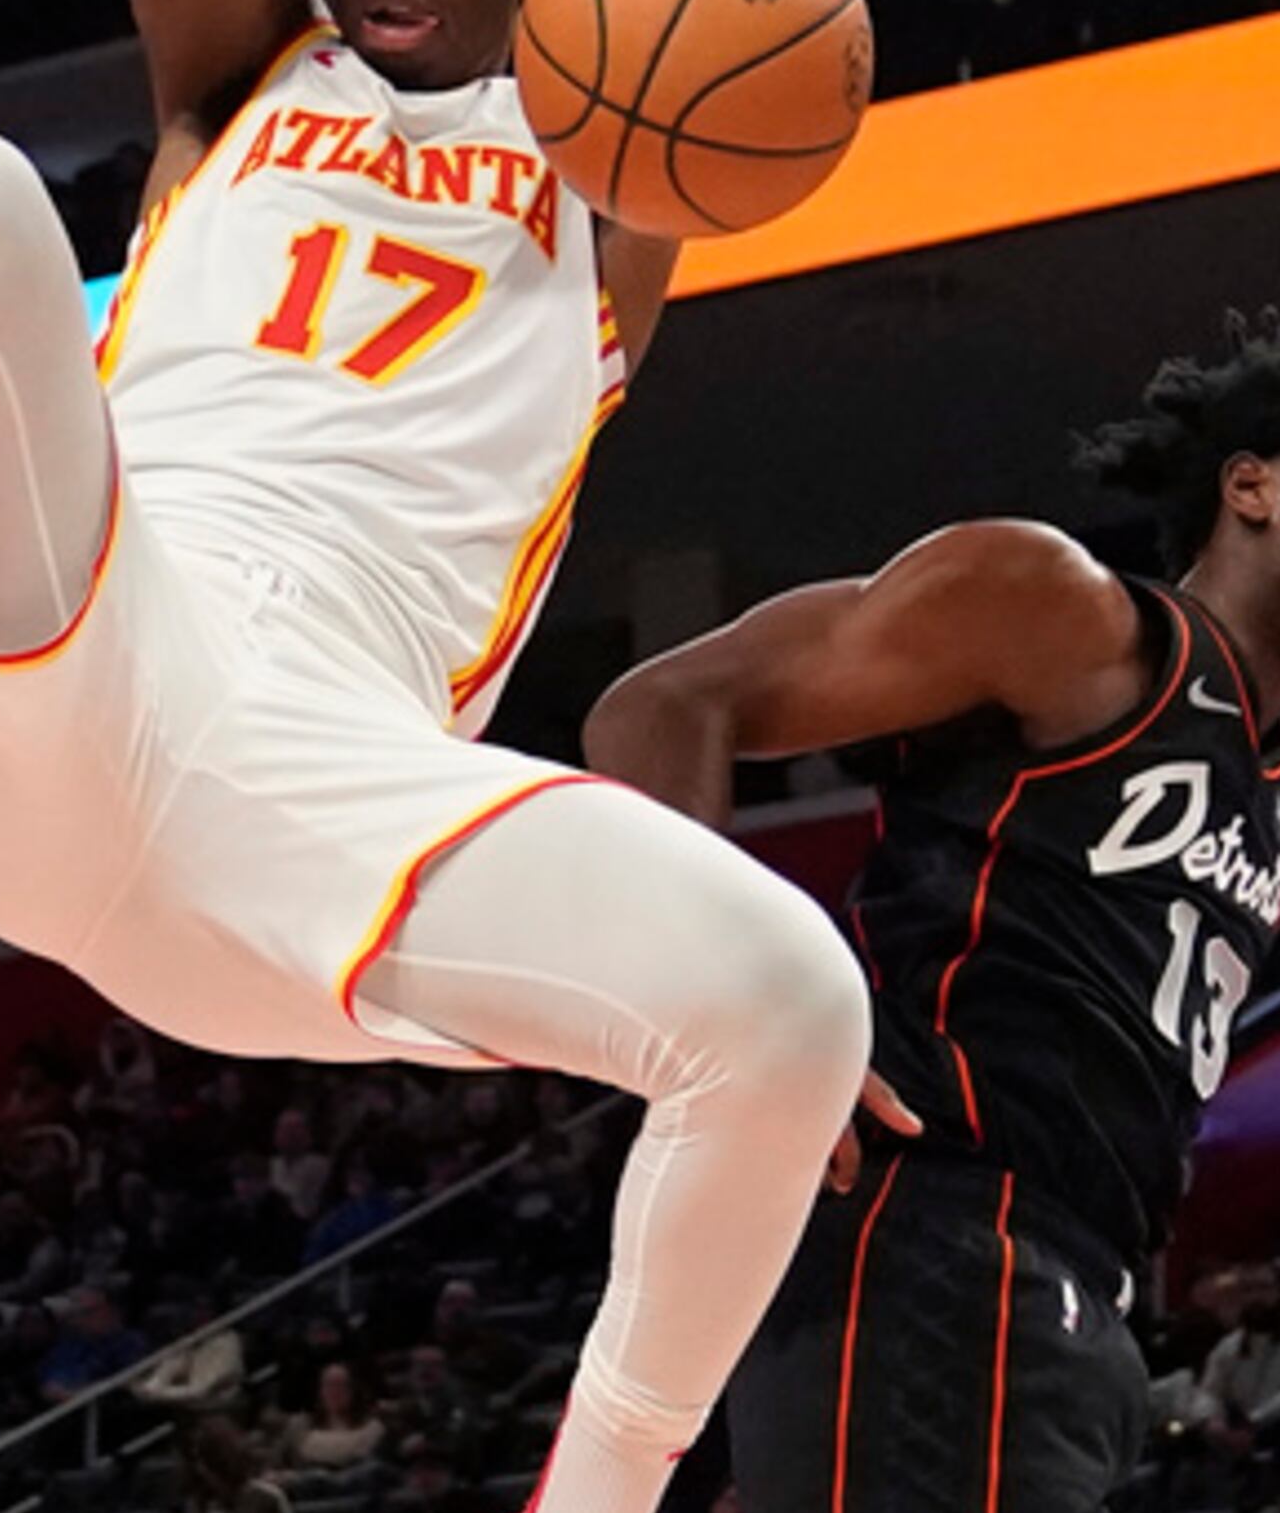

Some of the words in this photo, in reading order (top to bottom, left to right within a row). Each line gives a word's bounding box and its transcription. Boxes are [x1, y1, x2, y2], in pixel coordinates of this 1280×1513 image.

[229, 107, 560, 268] ATLANTA
[252, 219, 488, 391] 17
[1150, 897, 1253, 1101] 13
